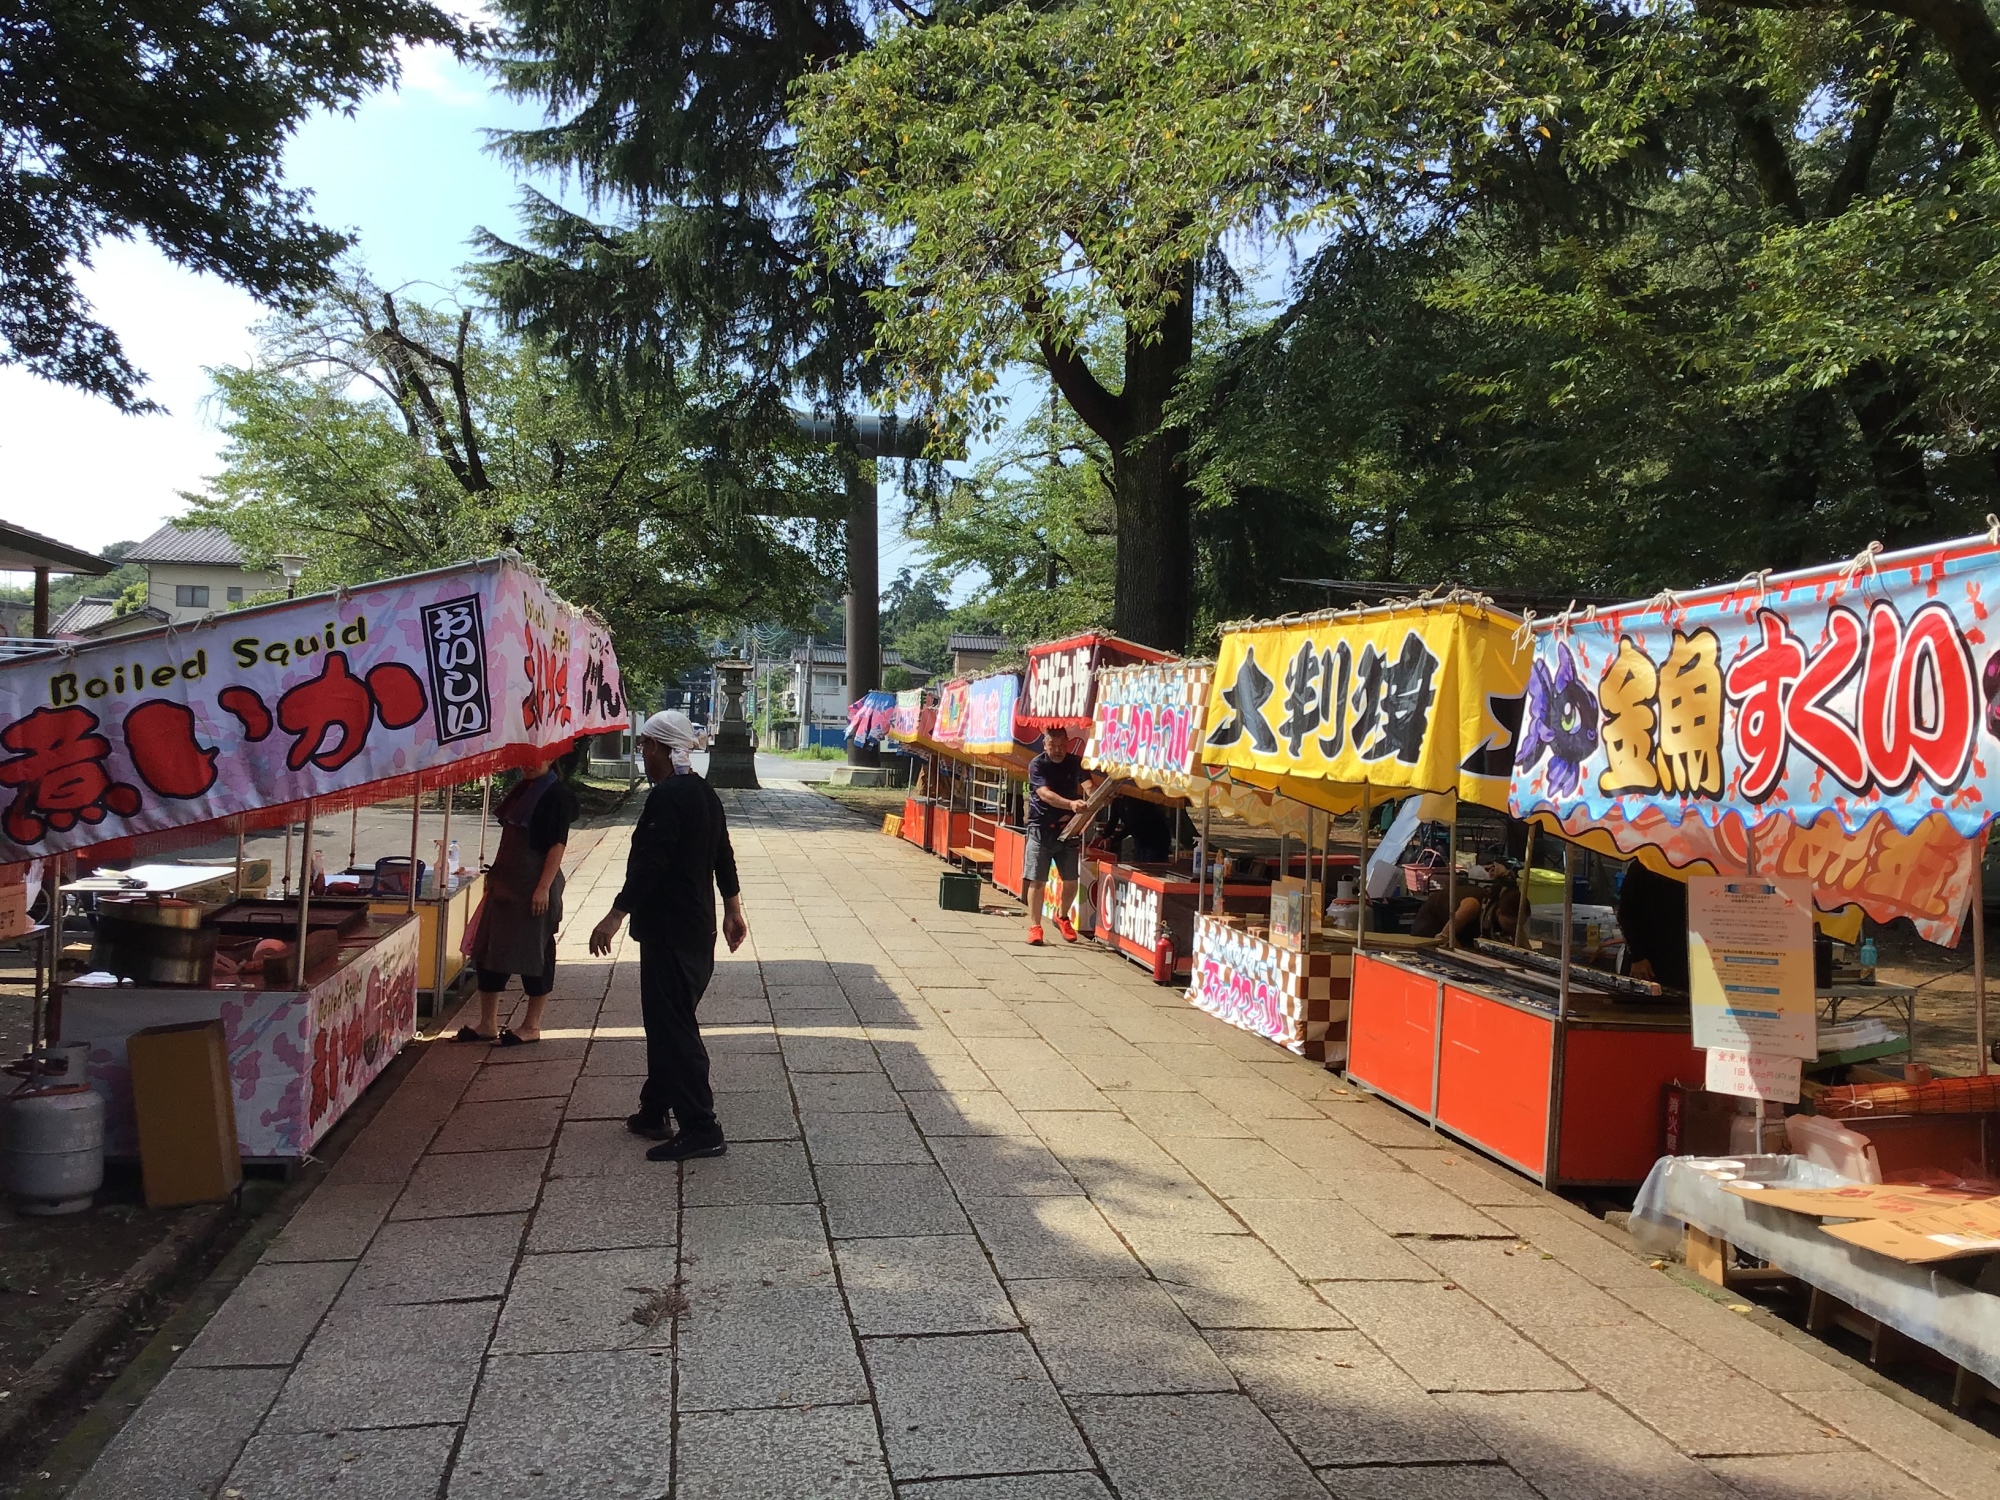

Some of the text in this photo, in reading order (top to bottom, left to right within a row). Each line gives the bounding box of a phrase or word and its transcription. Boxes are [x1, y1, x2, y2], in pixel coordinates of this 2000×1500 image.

[50, 615, 368, 707] Boiled Squid
[432, 605, 484, 737] おいしい
[1036, 646, 1091, 718] お好み焼
[1204, 628, 1443, 766] 大判焼
[1598, 599, 1981, 802] 金魚すくい
[0, 651, 428, 846] 煮いか
[1114, 881, 1158, 953] お好み焼
[317, 969, 363, 1024] Boiled Squid
[310, 1003, 363, 1130] 煮いか
[1667, 1096, 1680, 1151] 消火器
